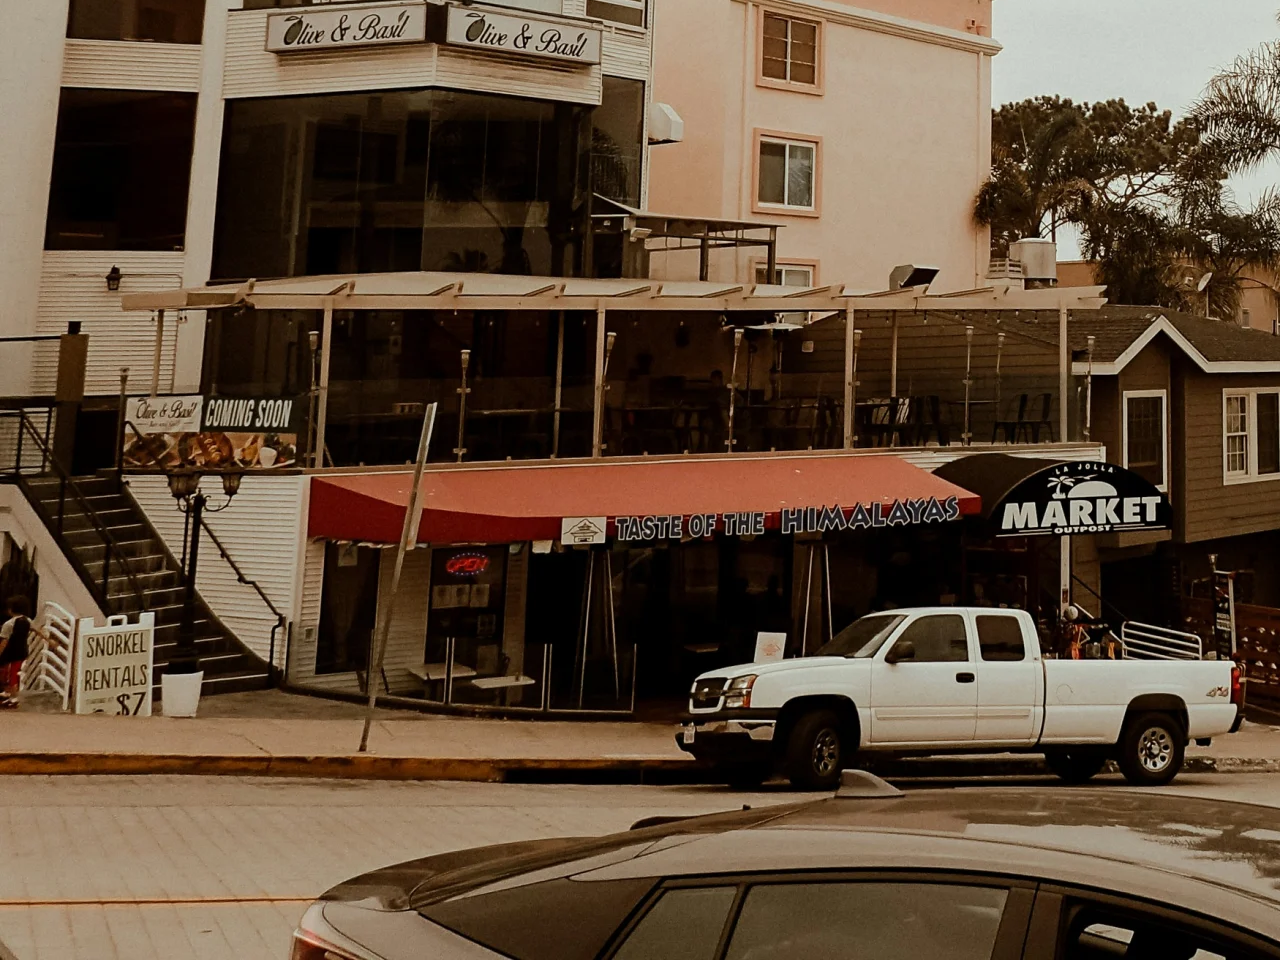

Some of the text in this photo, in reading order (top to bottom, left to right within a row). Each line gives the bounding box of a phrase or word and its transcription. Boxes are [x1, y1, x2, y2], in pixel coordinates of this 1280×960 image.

[283, 10, 410, 46] Olive & Basil
[465, 13, 588, 58] Olive & Basil
[136, 398, 198, 419] Olive & Basil
[205, 399, 293, 428] COMING SOON
[1055, 463, 1114, 475] LA JOLLA
[615, 496, 960, 540] TASTE OF THE HIMALAYAS
[1001, 496, 1162, 530] MARKET
[1054, 525, 1111, 534] OUTPOST
[446, 557, 489, 573] OPEN
[86, 632, 147, 658] SNORKEL
[84, 664, 148, 691] RENTALS
[116, 692, 147, 715] $7
